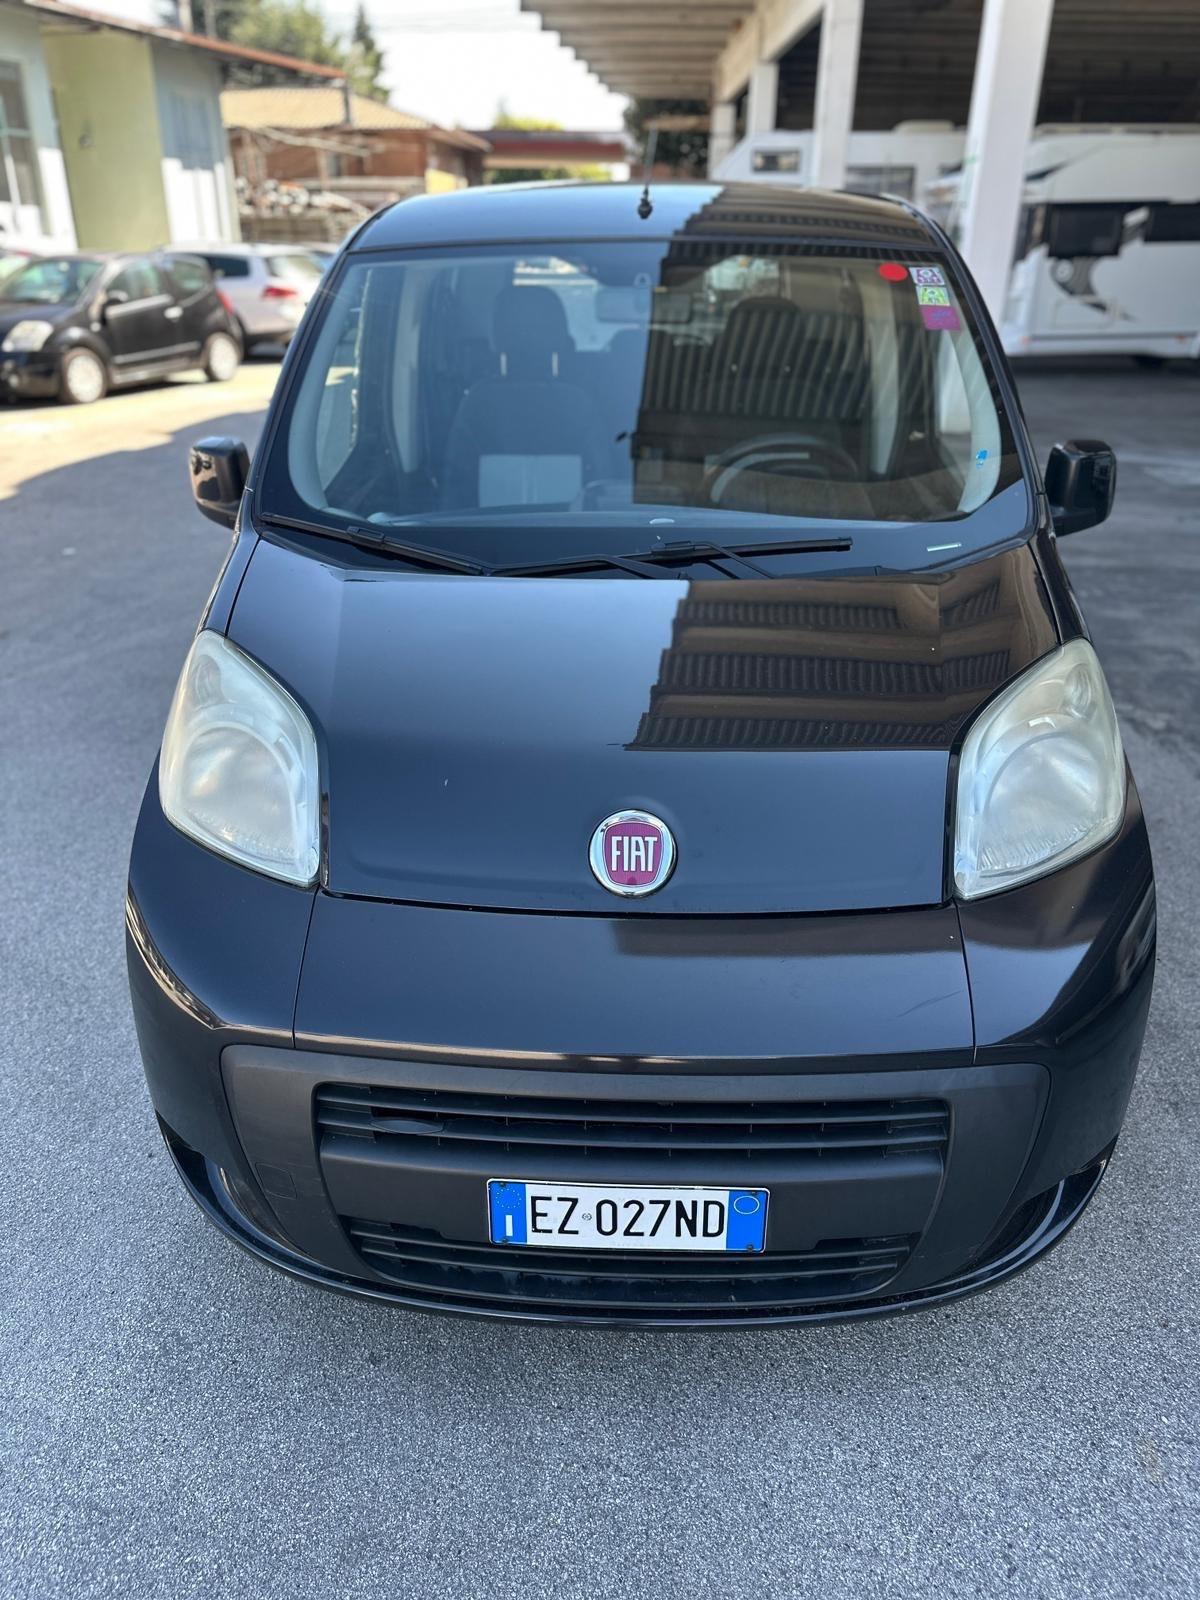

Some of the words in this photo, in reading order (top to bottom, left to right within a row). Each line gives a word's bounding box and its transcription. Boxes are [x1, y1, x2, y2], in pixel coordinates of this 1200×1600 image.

[611, 836, 658, 872] FIAT
[530, 1195, 579, 1235] EZ
[595, 1199, 725, 1238] 027ND
